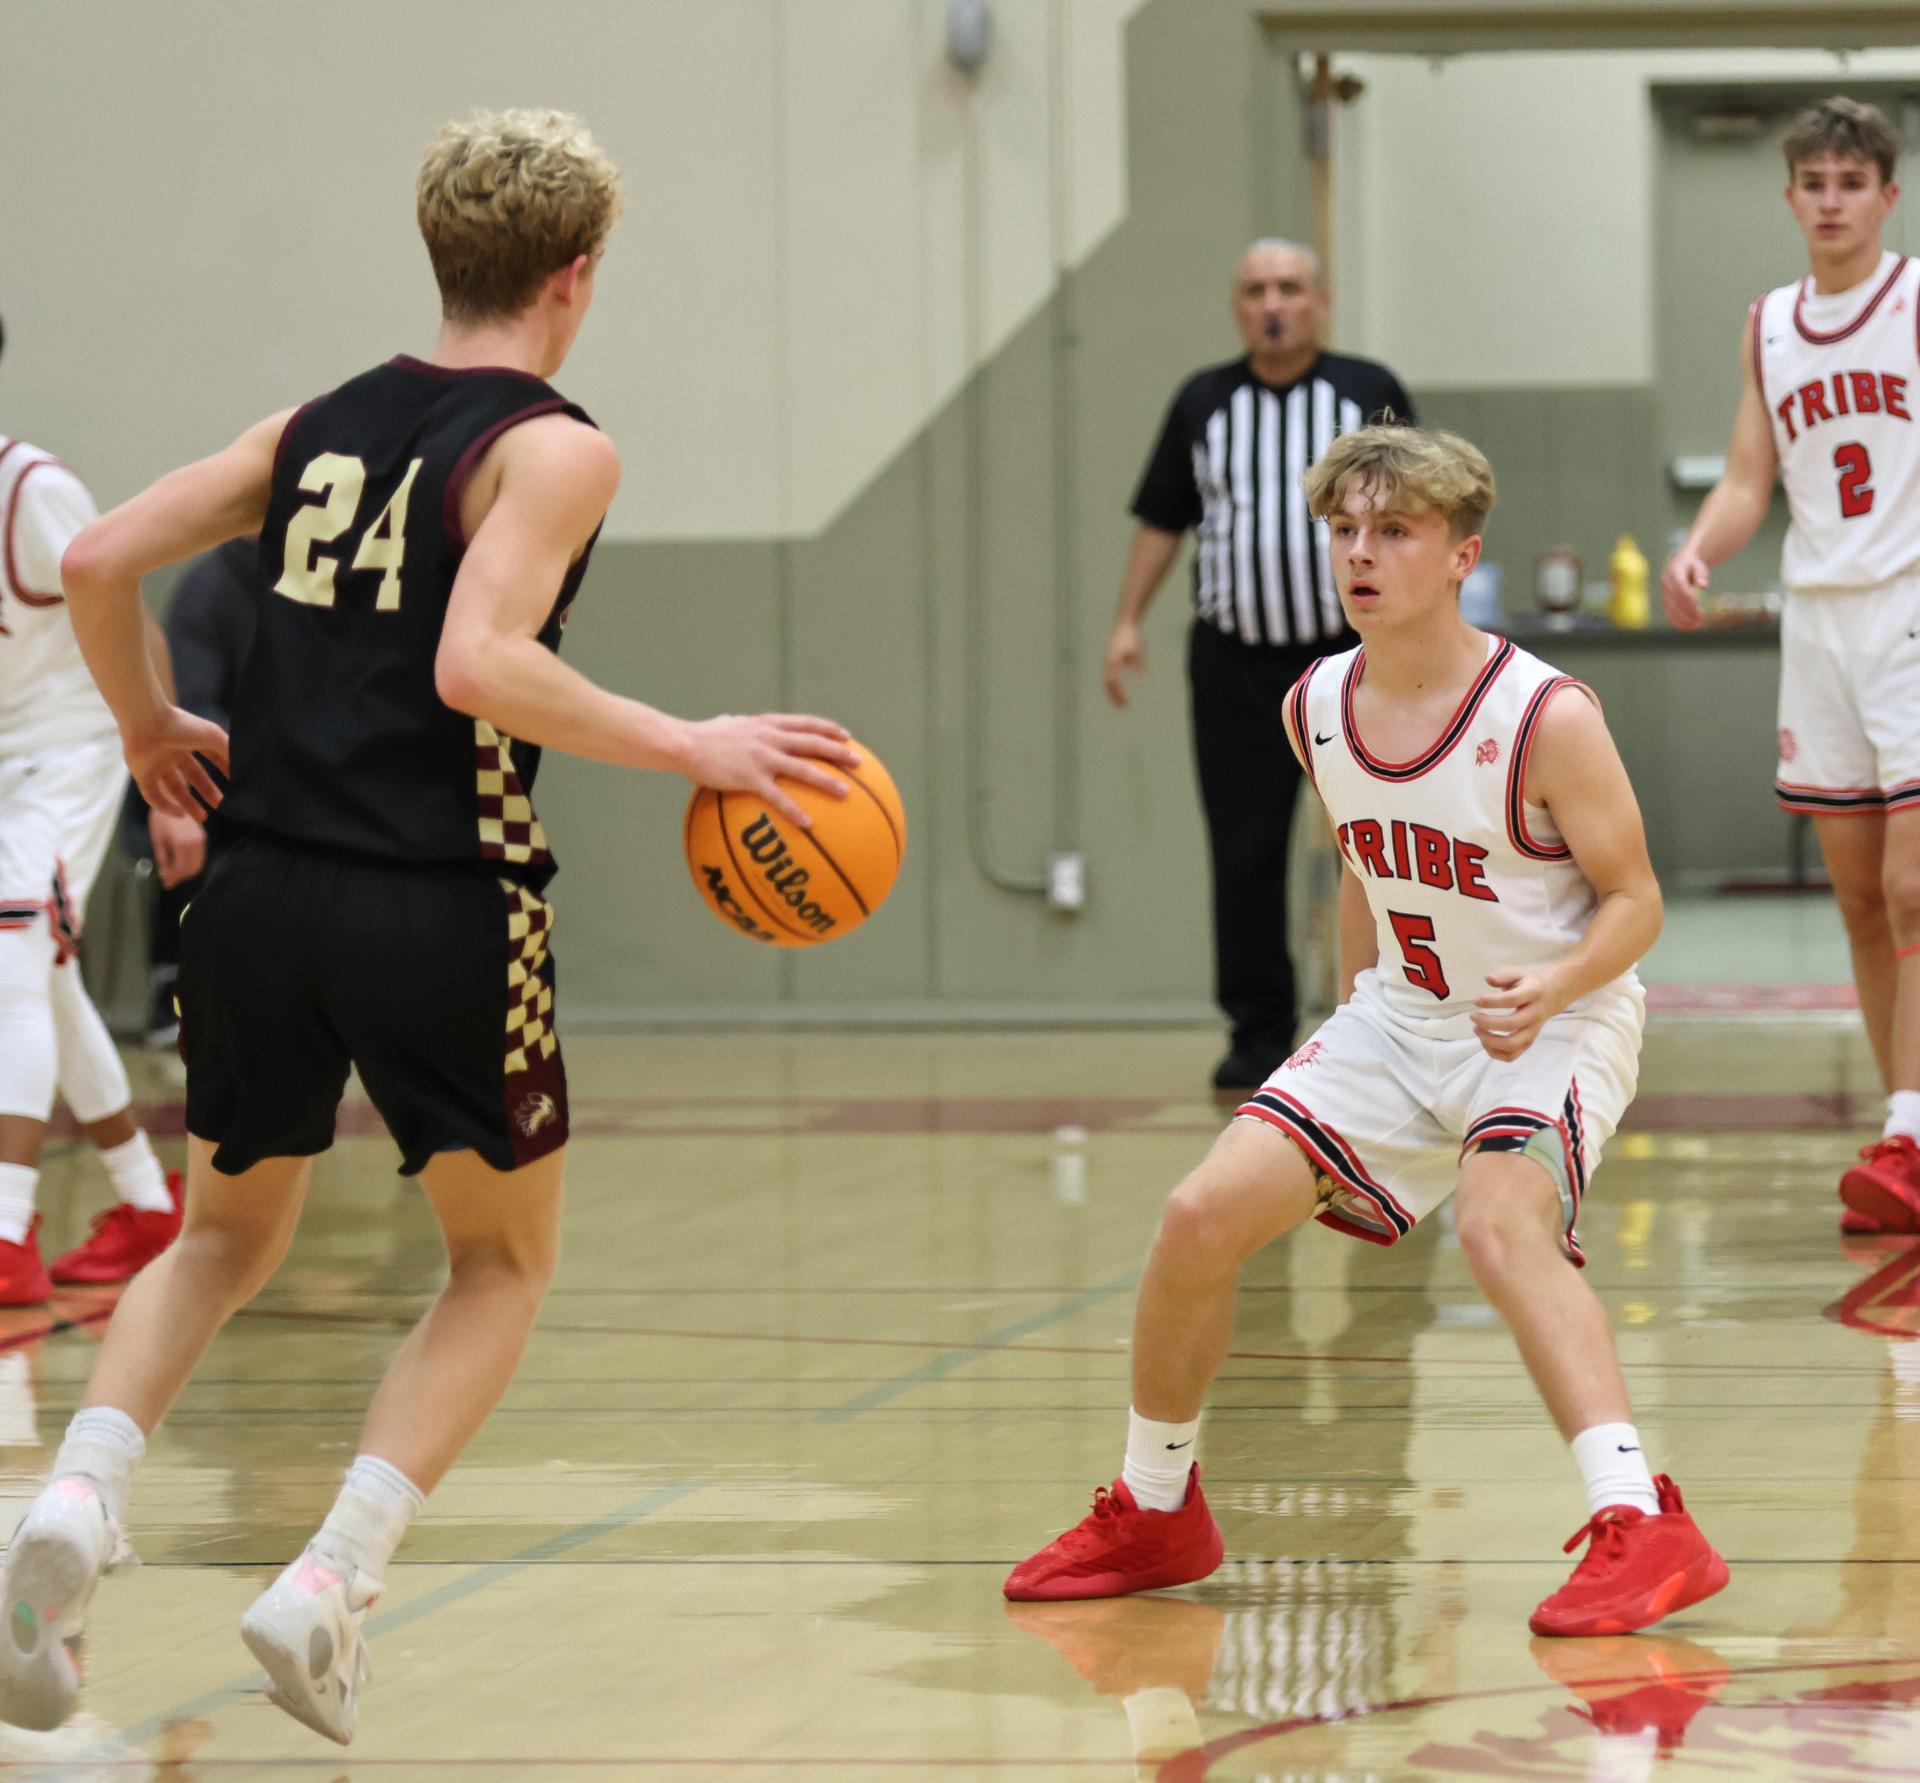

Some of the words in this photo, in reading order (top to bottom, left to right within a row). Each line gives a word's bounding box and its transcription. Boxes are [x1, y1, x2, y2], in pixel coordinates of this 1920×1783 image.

[1777, 370, 1912, 441] TRIBE
[1833, 441, 1874, 518] 2
[273, 451, 424, 611] 24
[740, 812, 836, 933] Wilson
[1387, 909, 1450, 1001] 5
